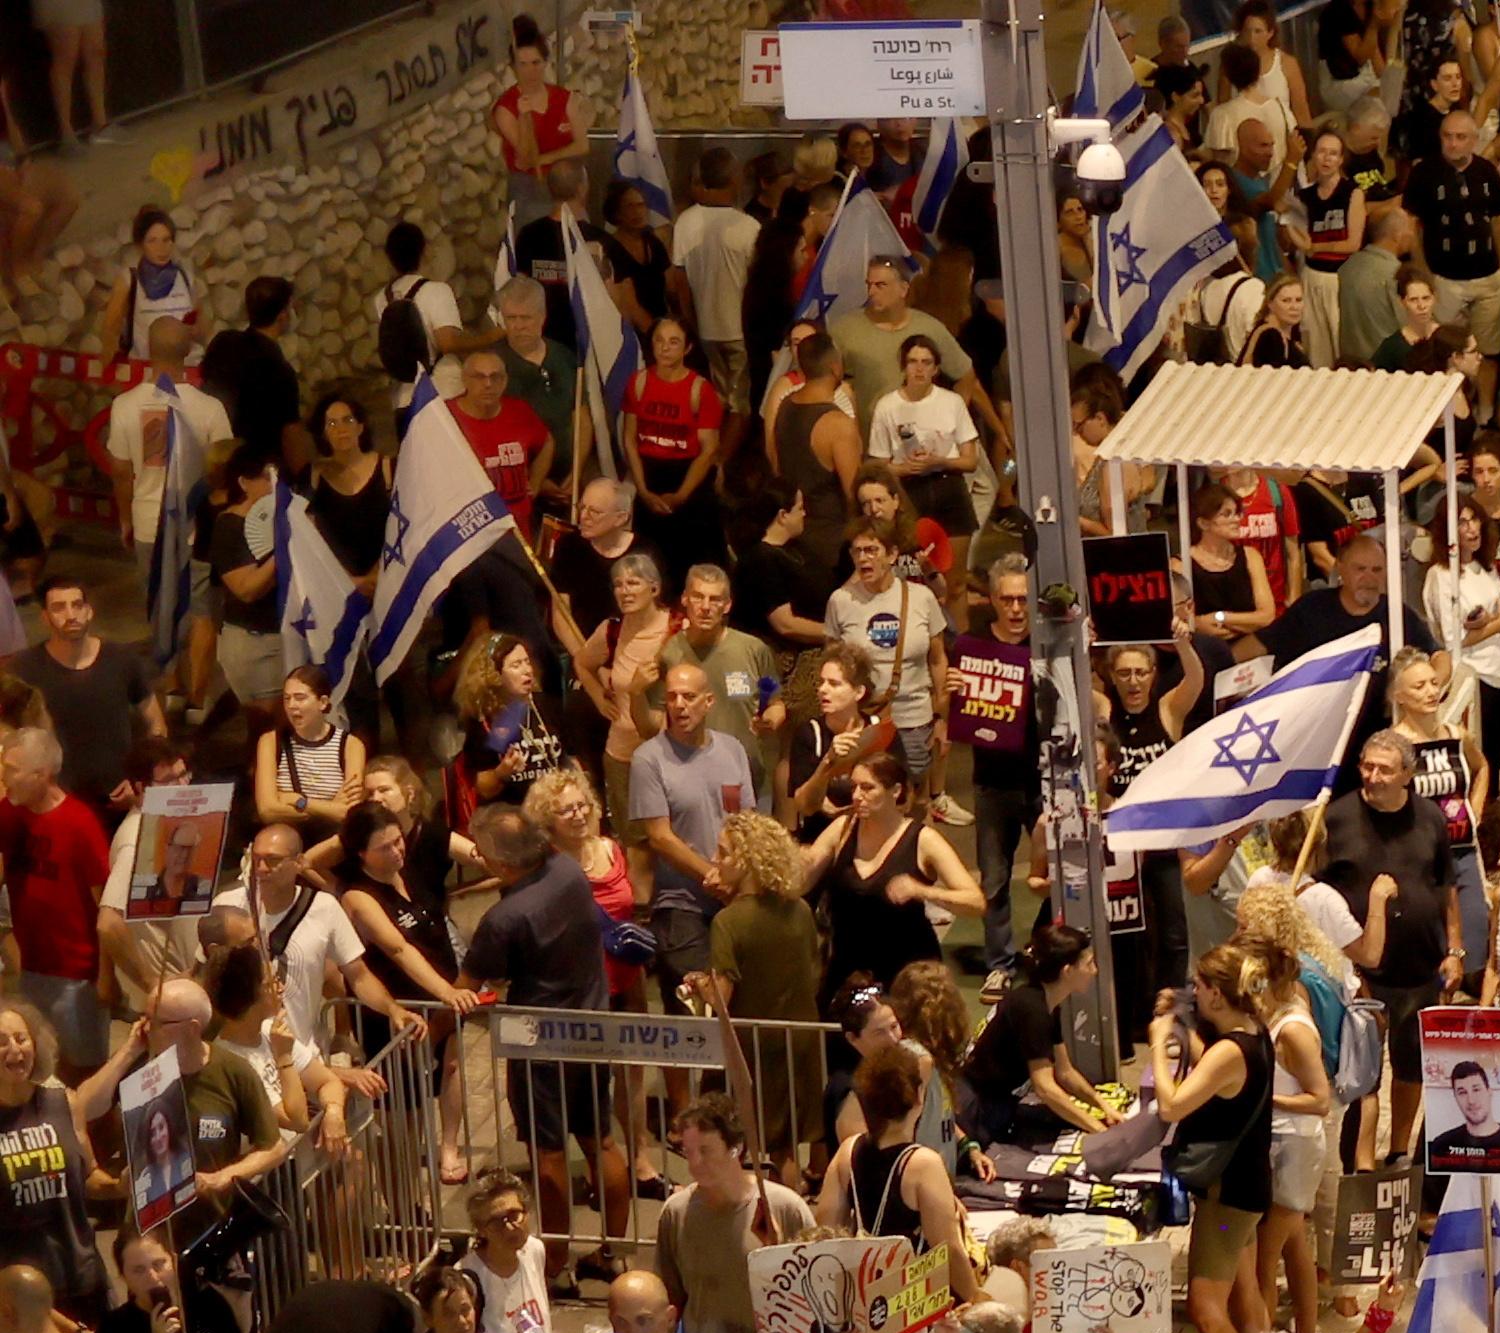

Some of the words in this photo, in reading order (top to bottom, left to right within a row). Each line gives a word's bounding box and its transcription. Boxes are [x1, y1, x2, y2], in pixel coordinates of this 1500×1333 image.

[872, 38, 920, 55] פועה
[938, 95, 956, 109] St.
[1091, 571, 1166, 602] הצילו
[961, 654, 1025, 681] המלחמה
[961, 675, 1025, 706] רעה
[619, 1022, 679, 1047] קשת
